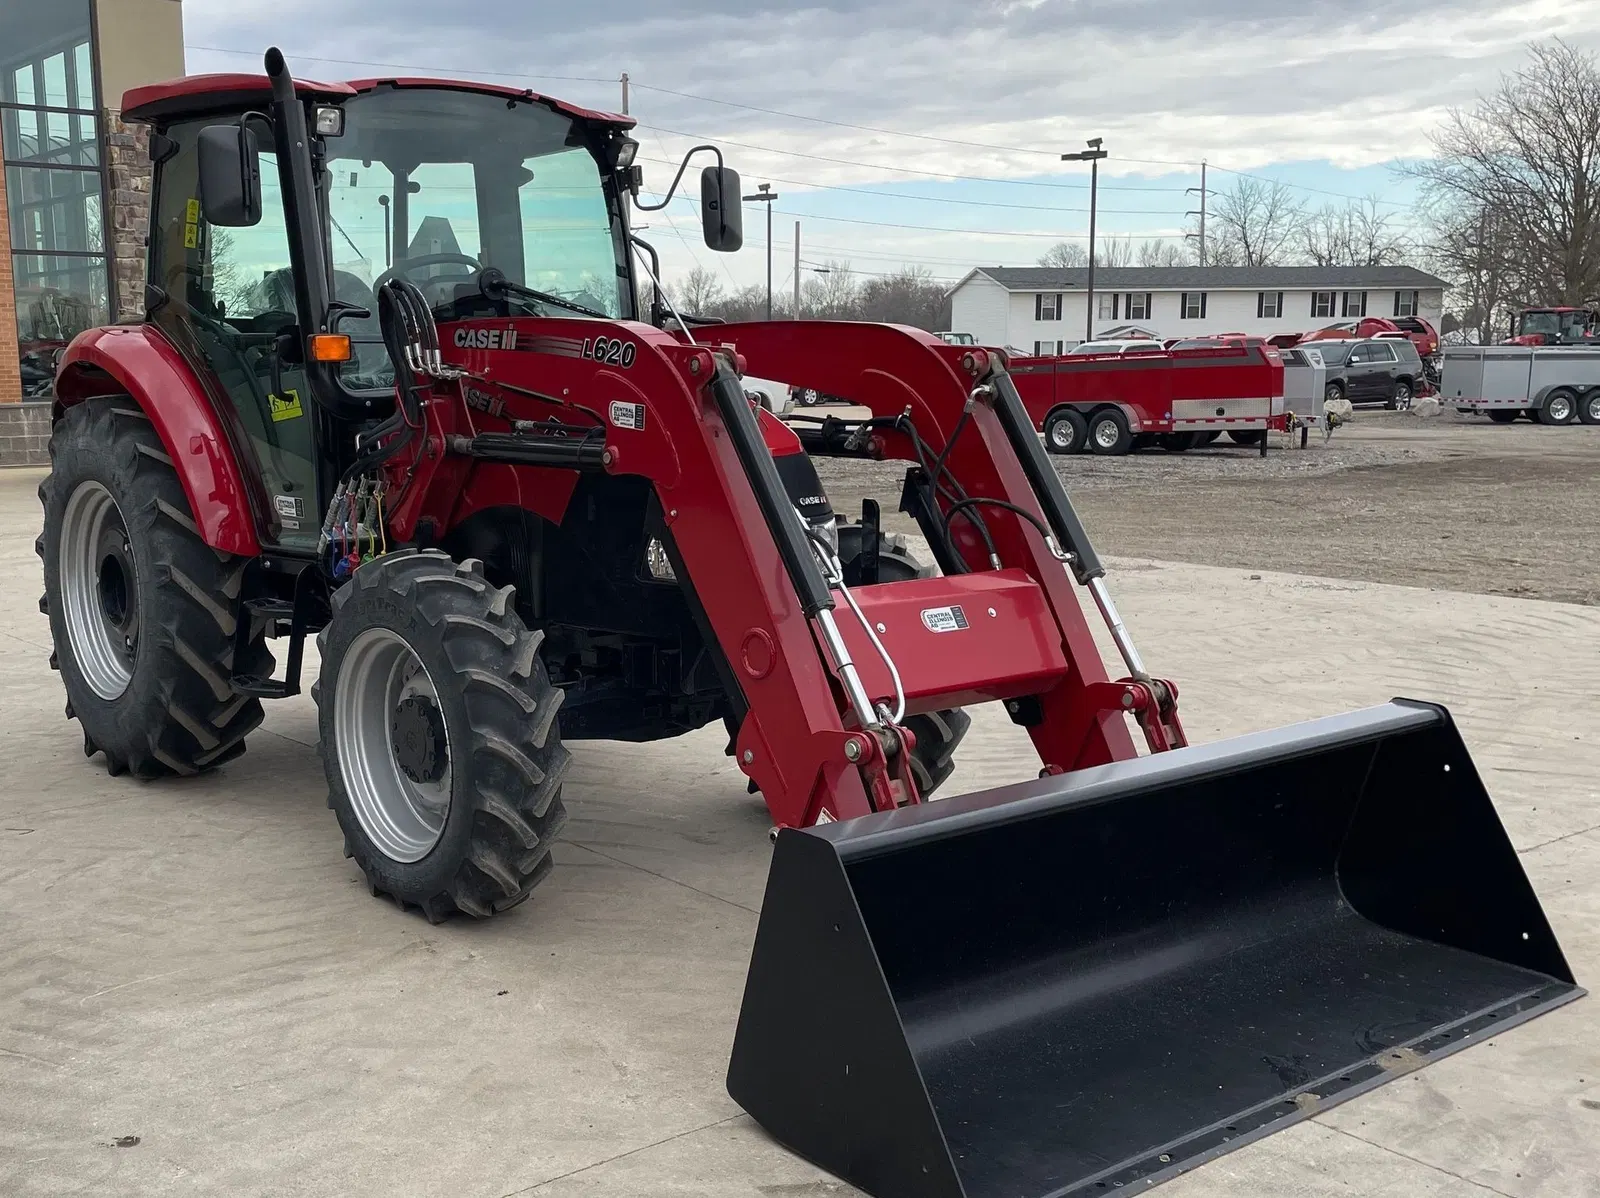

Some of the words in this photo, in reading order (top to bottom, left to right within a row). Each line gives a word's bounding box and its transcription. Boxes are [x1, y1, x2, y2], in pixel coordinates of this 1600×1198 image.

[454, 328, 500, 349] CASE
[581, 335, 637, 369] L620
[613, 405, 634, 414] CENTRAL
[613, 411, 634, 419] ILLINOIS
[799, 496, 820, 506] CASE
[929, 616, 954, 624] ILLINOIS
